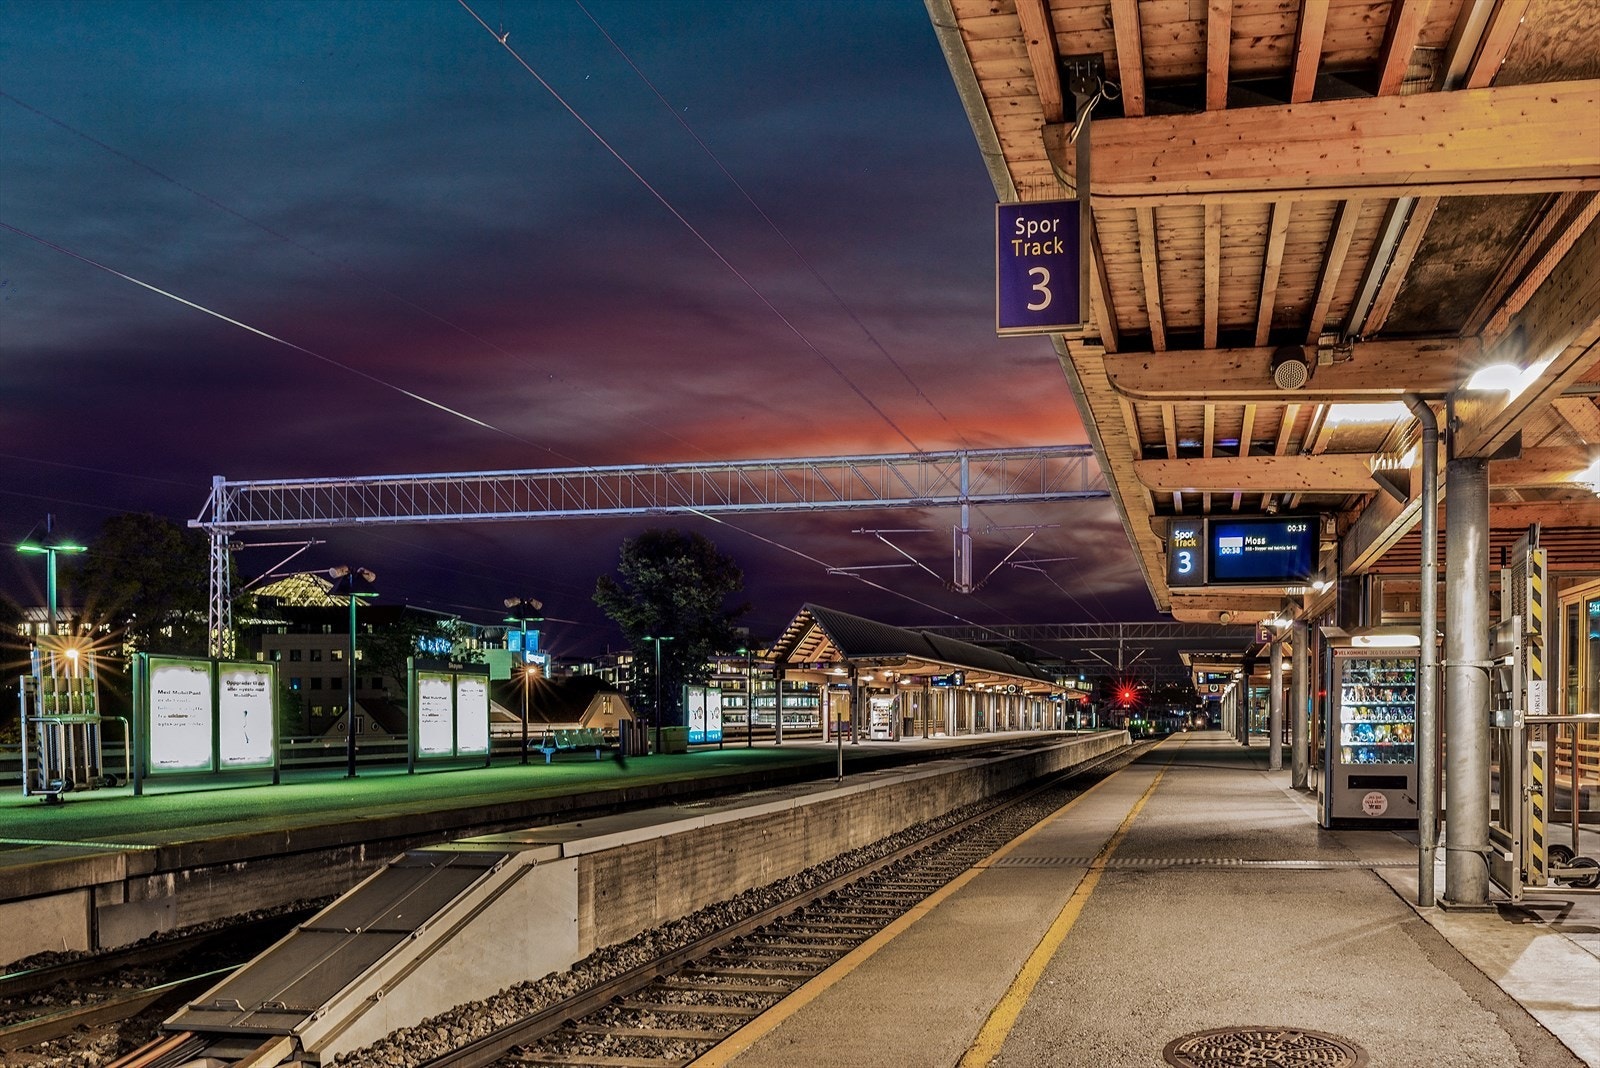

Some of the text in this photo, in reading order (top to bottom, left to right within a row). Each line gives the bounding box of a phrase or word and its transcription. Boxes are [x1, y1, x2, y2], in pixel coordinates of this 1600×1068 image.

[1015, 217, 1060, 239] Spor
[1011, 236, 1064, 257] Track
[1027, 266, 1052, 311] 3
[1174, 530, 1194, 541] Spor
[1174, 538, 1197, 548] Track
[1245, 536, 1266, 546] Moss
[1178, 551, 1192, 573] 3
[1261, 630, 1268, 640] E
